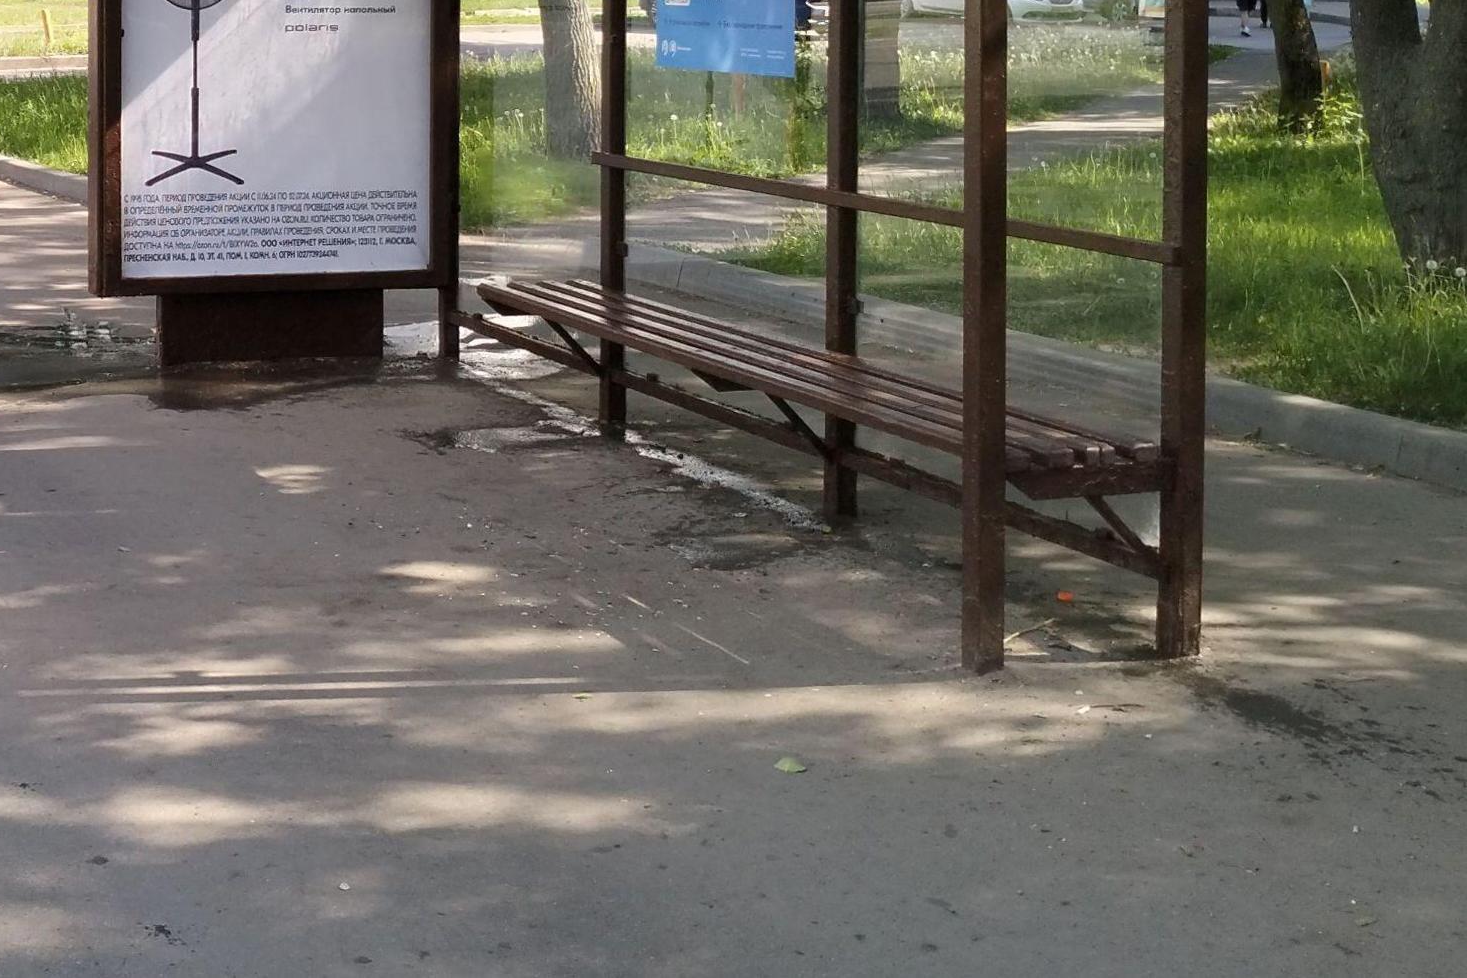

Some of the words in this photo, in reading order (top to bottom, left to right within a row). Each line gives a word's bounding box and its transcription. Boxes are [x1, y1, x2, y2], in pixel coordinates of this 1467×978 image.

[285, 5, 341, 15] Вентилятор
[343, 5, 396, 14] напольный
[284, 24, 339, 33] polaris
[224, 204, 270, 213] ПРОМЕЖУТОК
[260, 239, 278, 247] ООО
[123, 253, 171, 263] ПРЕСНЕНСКАЯ
[278, 250, 296, 259] ОГРН
